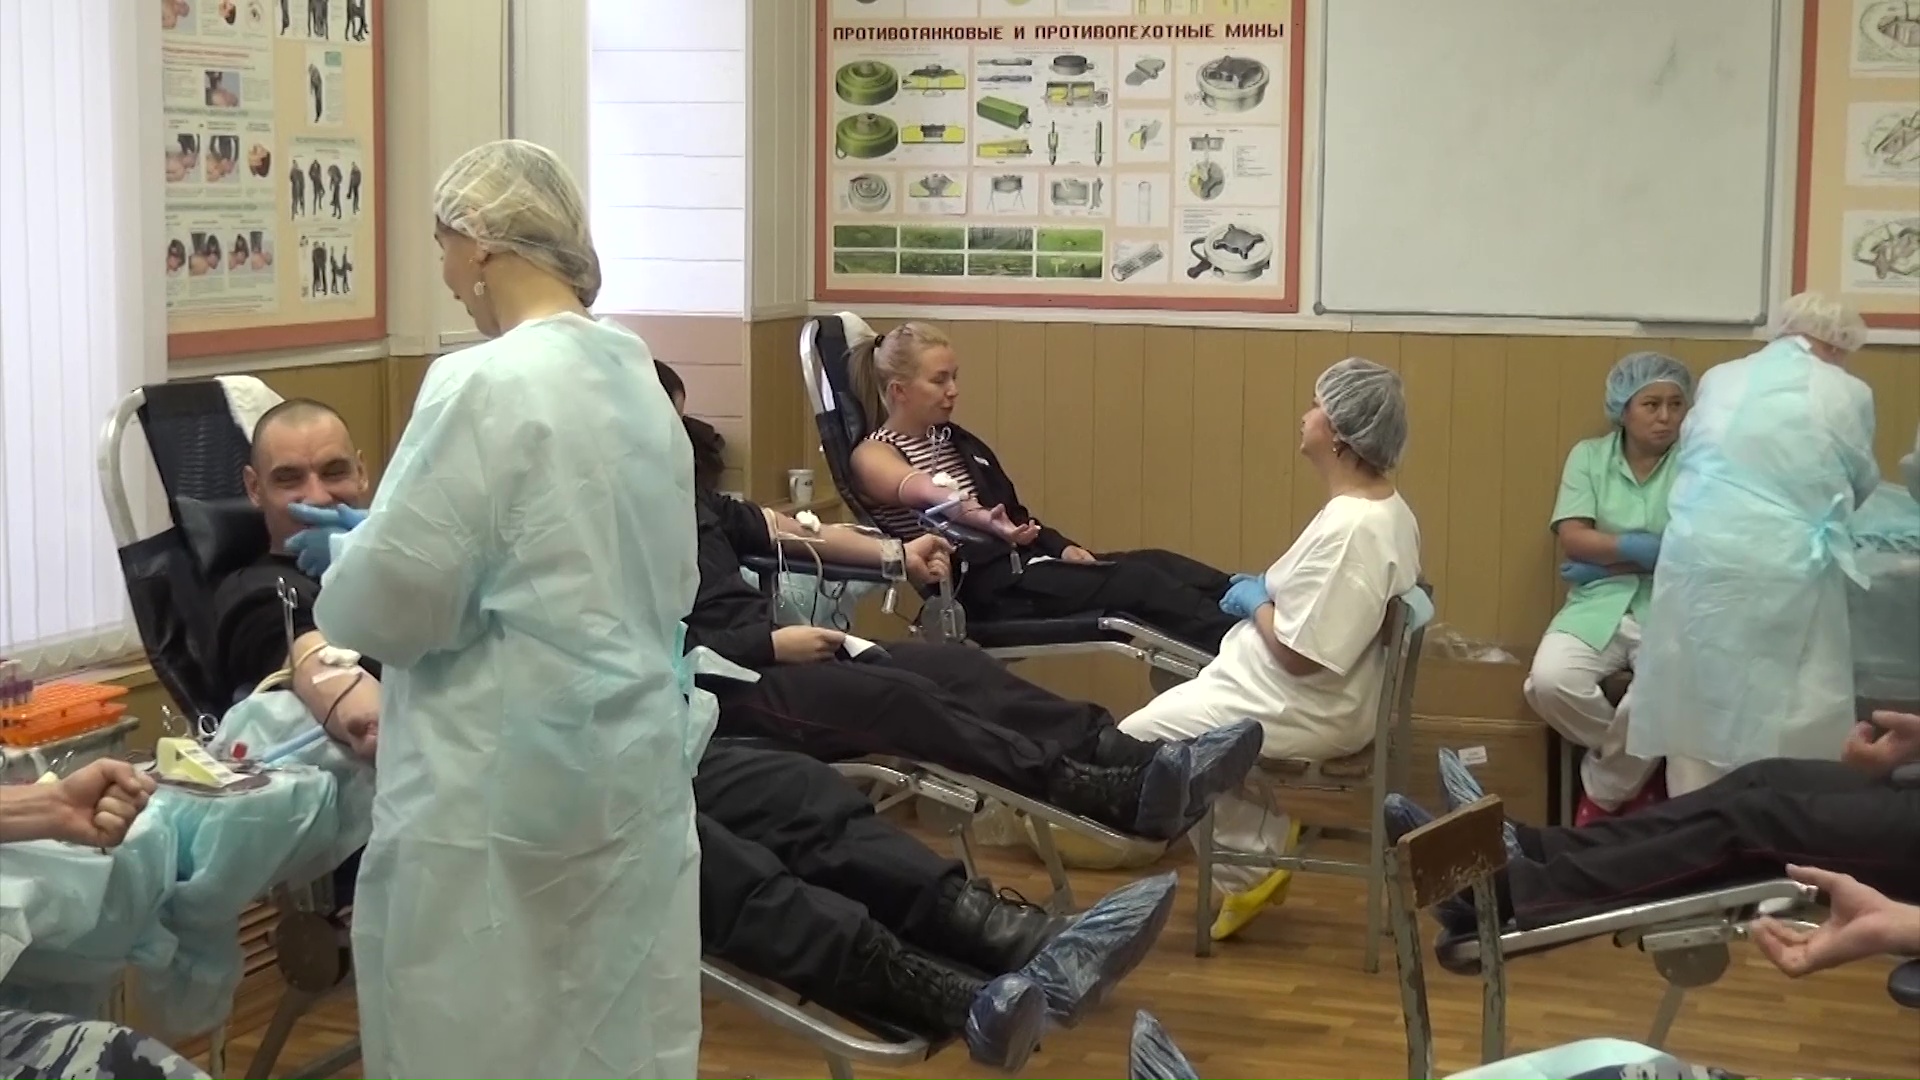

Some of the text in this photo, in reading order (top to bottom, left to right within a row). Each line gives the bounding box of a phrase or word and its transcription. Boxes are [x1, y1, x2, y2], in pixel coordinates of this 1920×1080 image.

[833, 23, 1284, 41] ПРОТИВОТАНКОВЫЕ И ПРОТИВОПЕХОТНЫЕ МИНЫ
